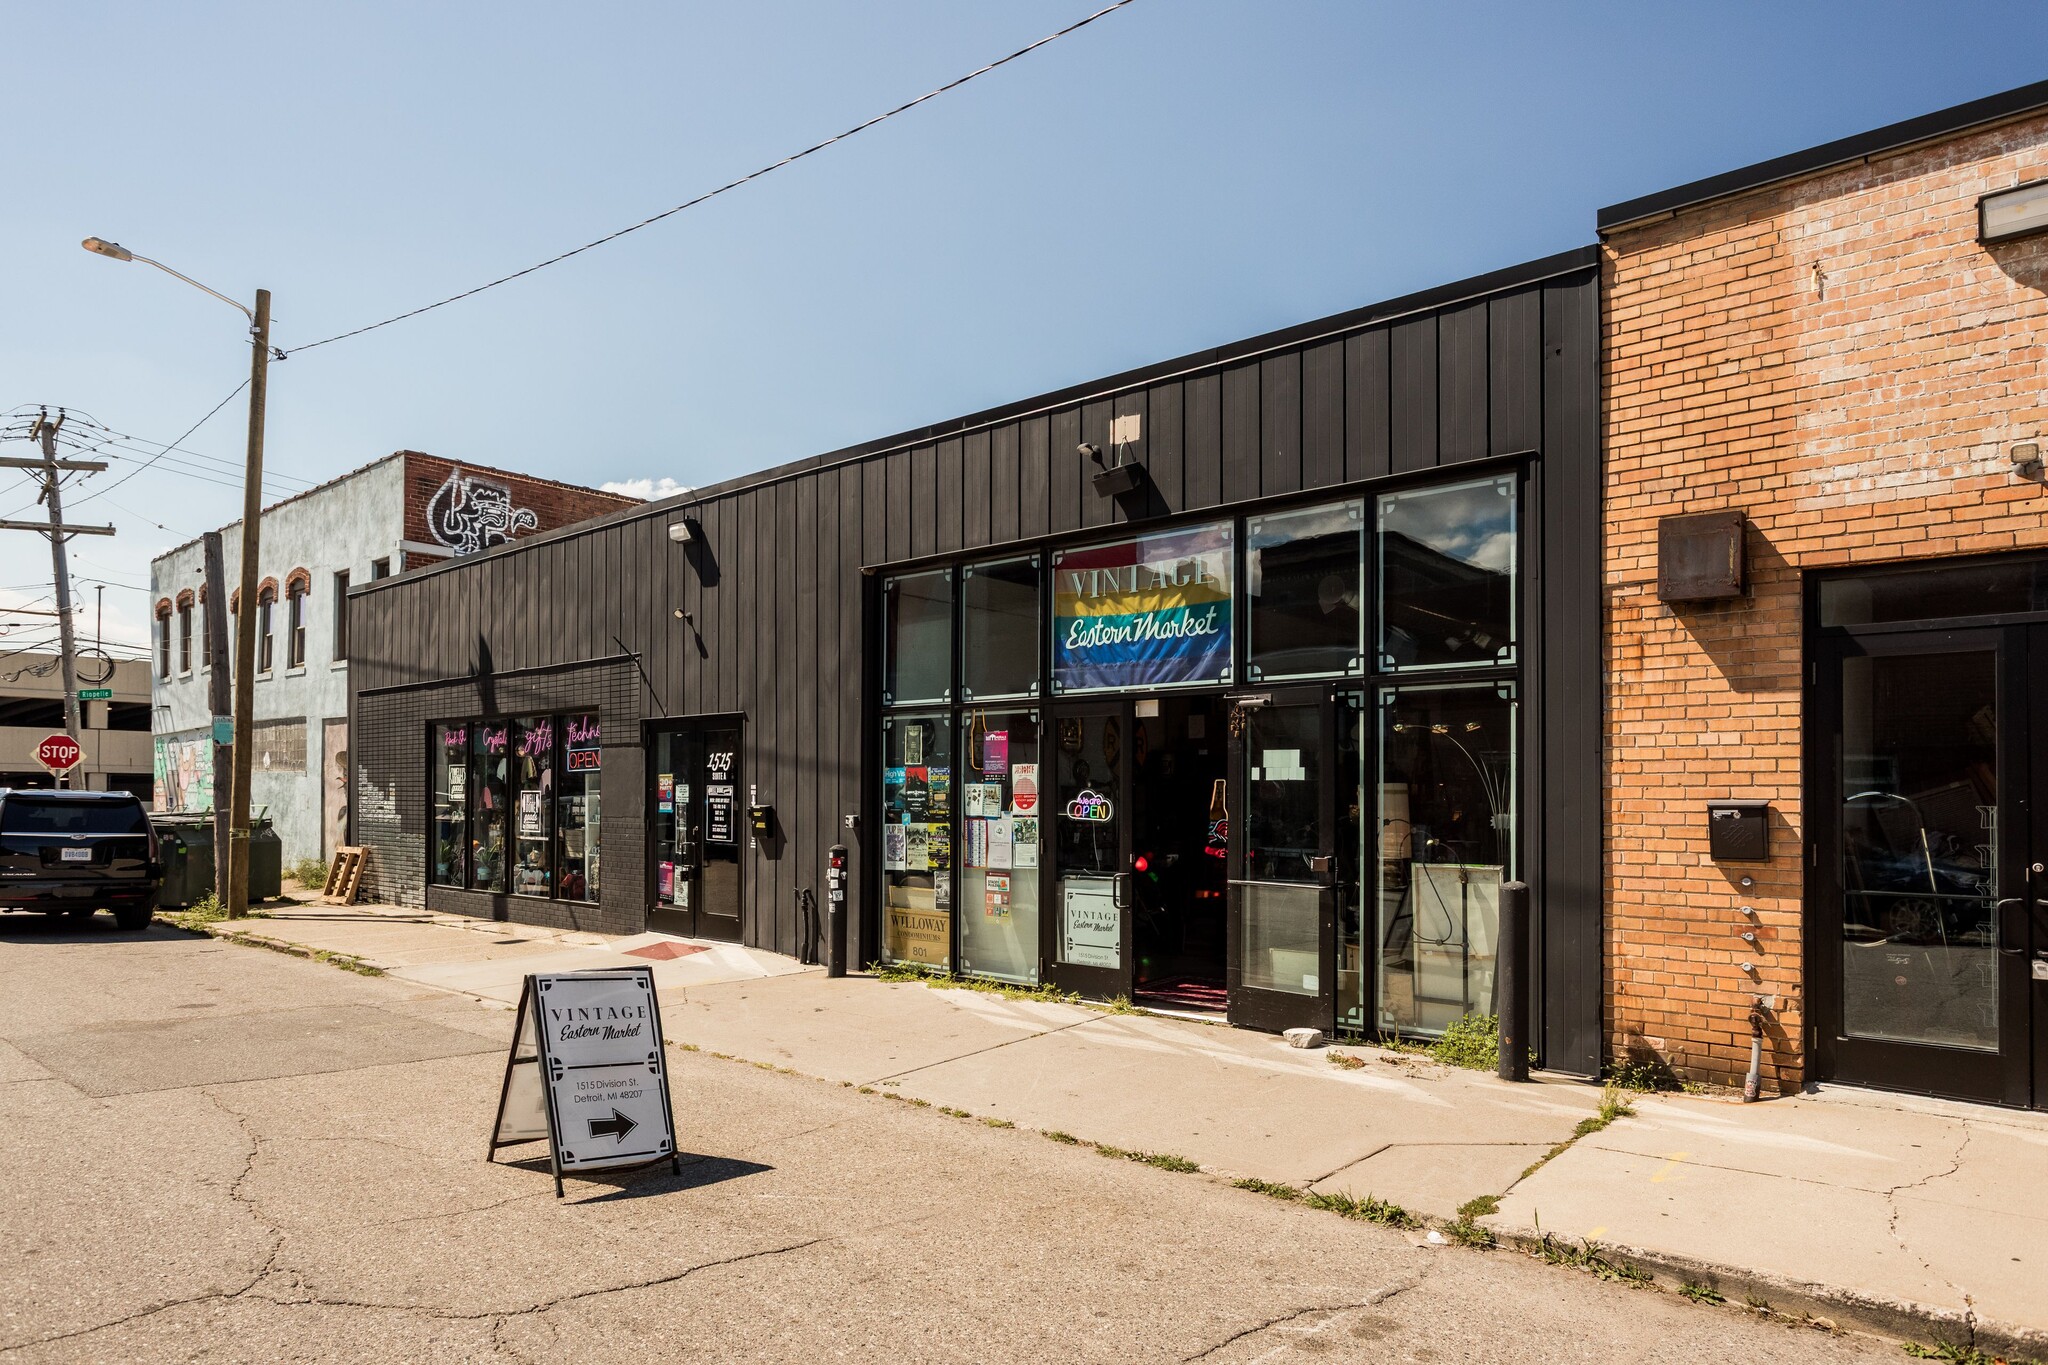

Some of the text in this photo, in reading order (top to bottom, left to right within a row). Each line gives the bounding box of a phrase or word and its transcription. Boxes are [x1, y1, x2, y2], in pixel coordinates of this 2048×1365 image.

[1072, 557, 1214, 599] VINTAGE
[1066, 606, 1218, 649] Eastern Market
[82, 690, 109, 698] Riopelle
[525, 720, 552, 755] gifts
[41, 745, 78, 759] STOP
[569, 751, 601, 769] OPEN
[707, 752, 733, 771] 1515
[1074, 804, 1106, 819] OPEN
[891, 914, 946, 932] WILLOWAY
[1071, 910, 1118, 921] VINTAGE
[1073, 920, 1093, 930] Eastern
[897, 930, 940, 941] CONDOMINIUMS
[912, 946, 927, 957] 801
[551, 1006, 646, 1021] VINTAGE
[560, 1022, 641, 1041] Eastern Market
[576, 1078, 639, 1090] 1515 Division St.
[574, 1093, 605, 1103] Detroit,
[620, 1090, 643, 1099] 48207
